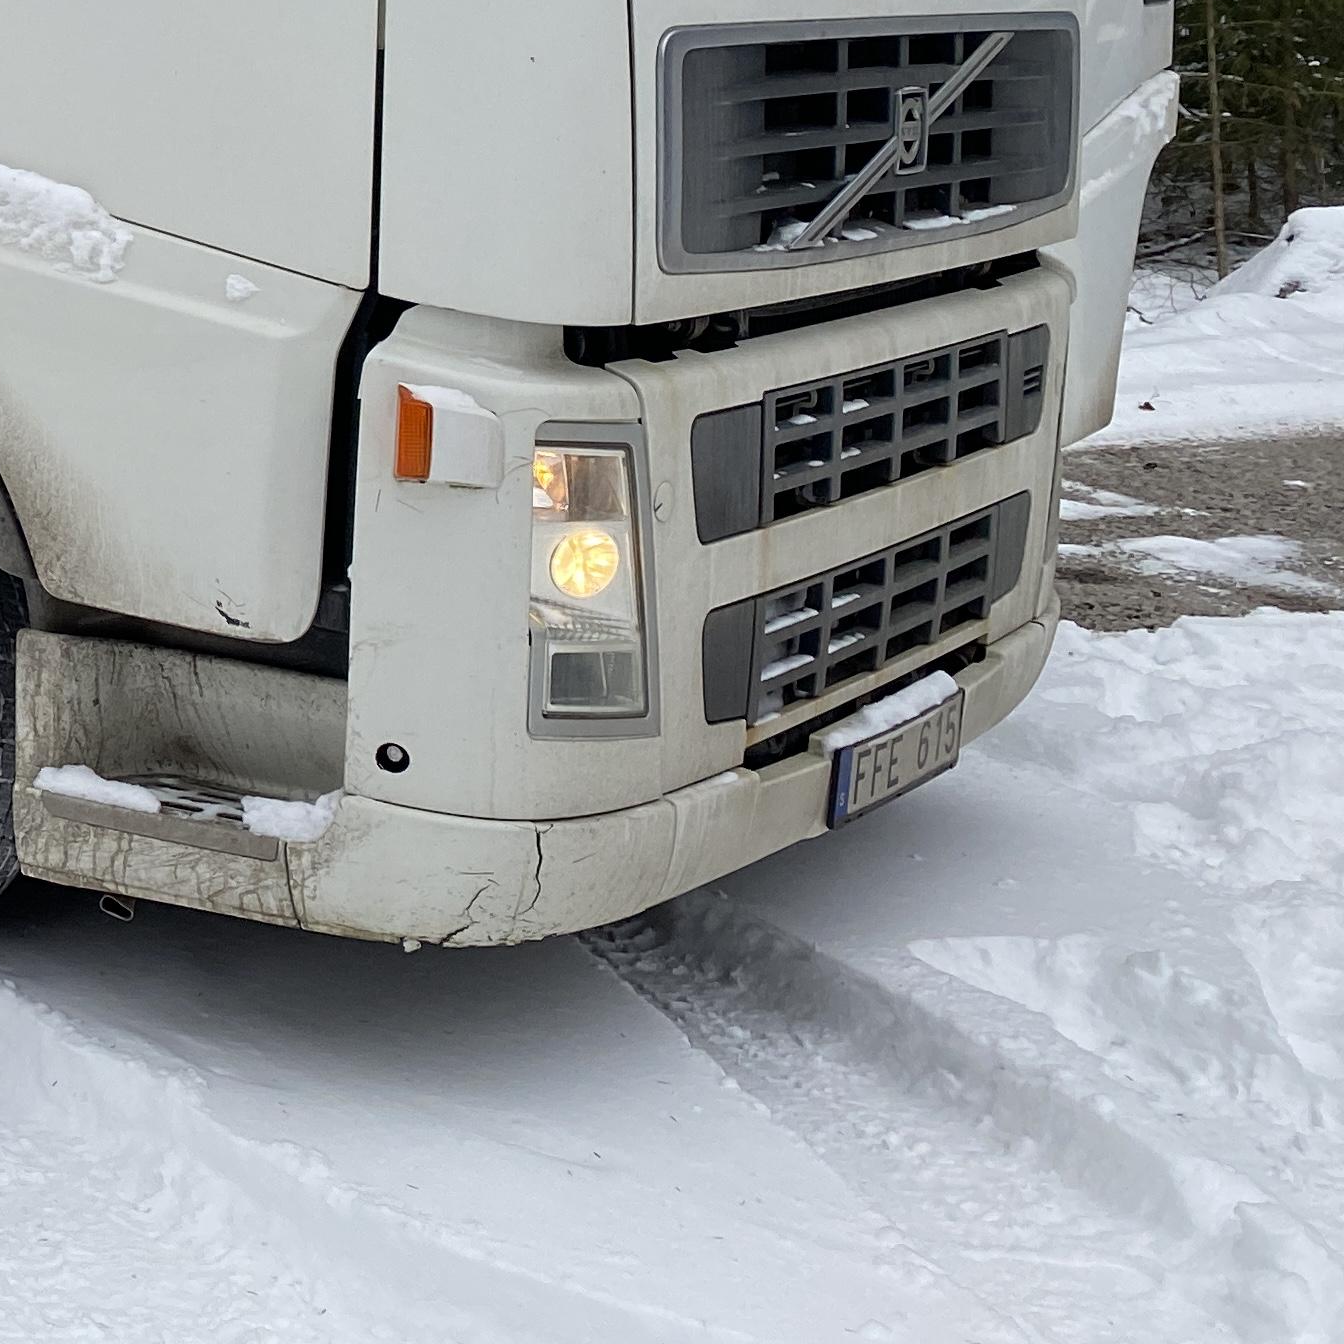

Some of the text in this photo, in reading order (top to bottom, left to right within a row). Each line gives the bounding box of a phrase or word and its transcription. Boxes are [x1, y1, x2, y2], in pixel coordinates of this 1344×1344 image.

[852, 703, 957, 806] FFE 615
[838, 791, 846, 808] S
